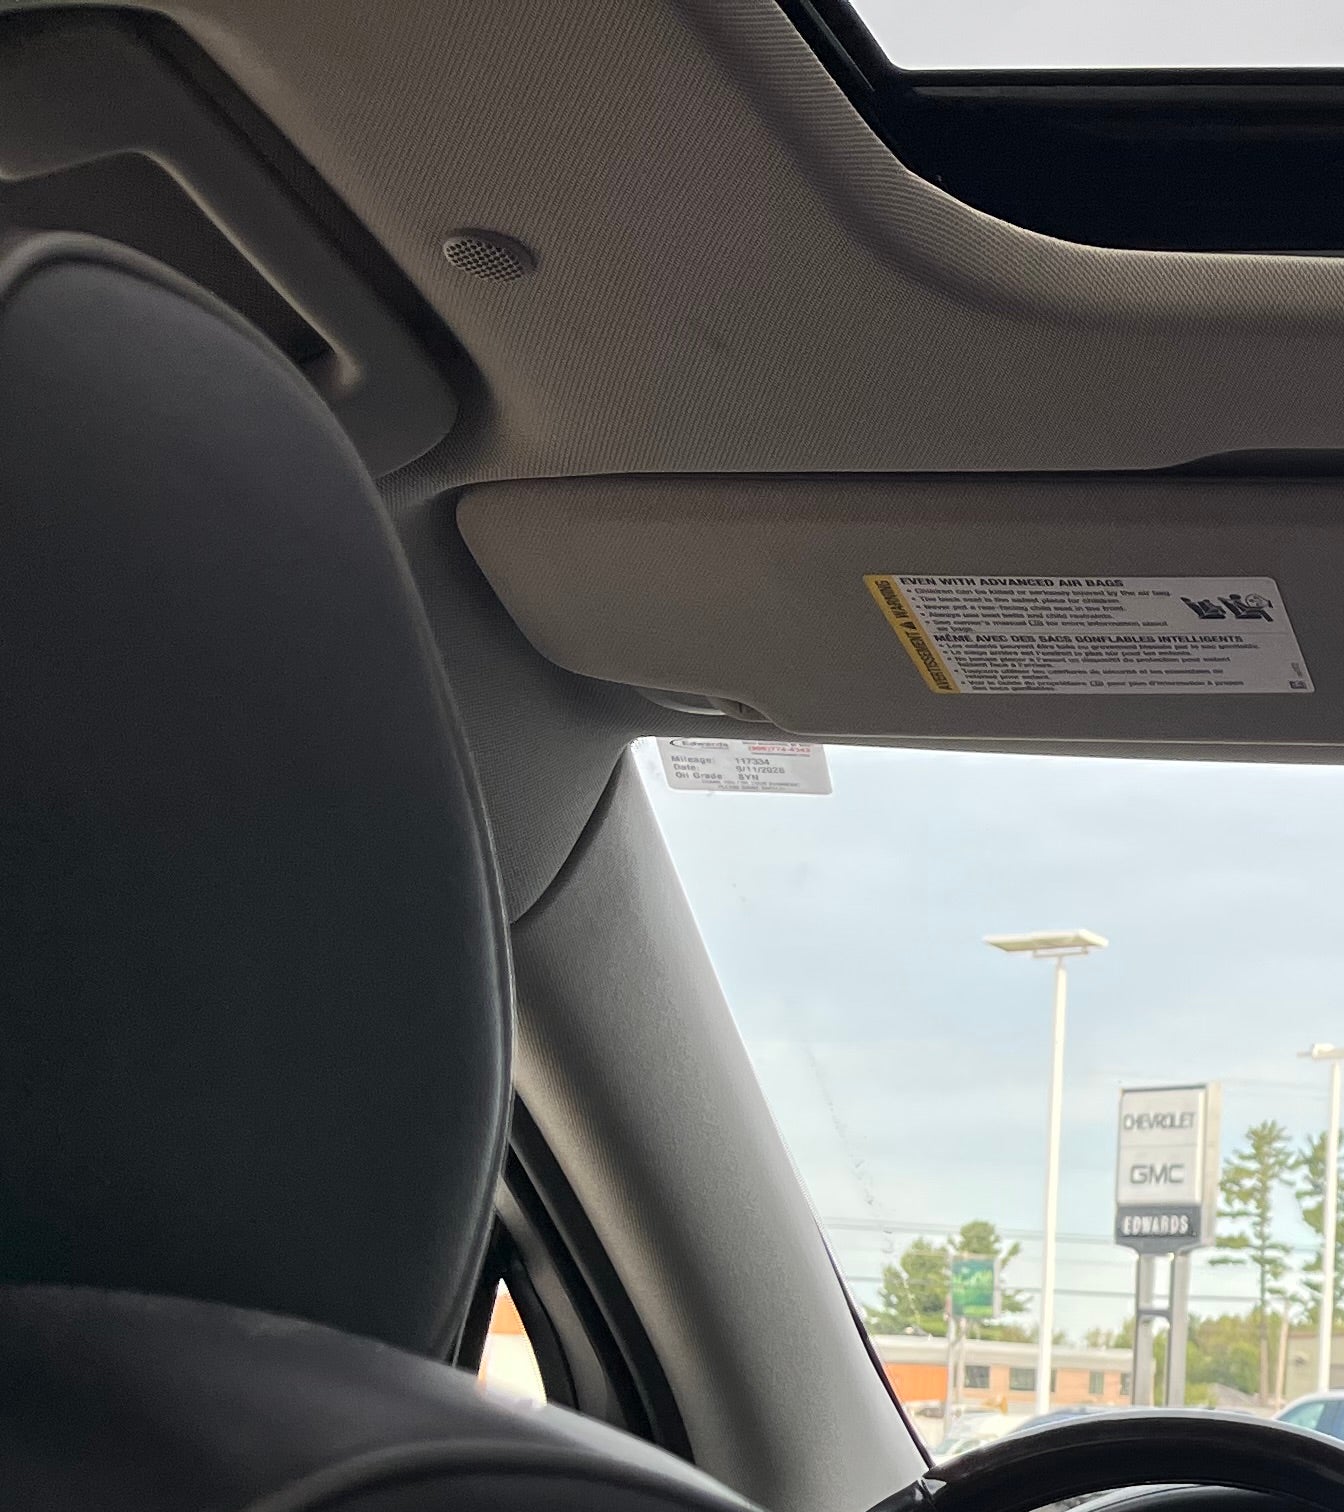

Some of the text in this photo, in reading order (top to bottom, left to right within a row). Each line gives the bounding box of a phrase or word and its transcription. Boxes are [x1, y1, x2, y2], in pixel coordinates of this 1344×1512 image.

[900, 577, 937, 585] EVEN
[939, 577, 976, 585] WITH
[980, 578, 1054, 587] ADVANCED
[1060, 579, 1082, 587] AIR
[1123, 1112, 1195, 1130] CHEVROLET
[1130, 1164, 1185, 1185] GMC
[1123, 1214, 1189, 1235] EDWARDS
